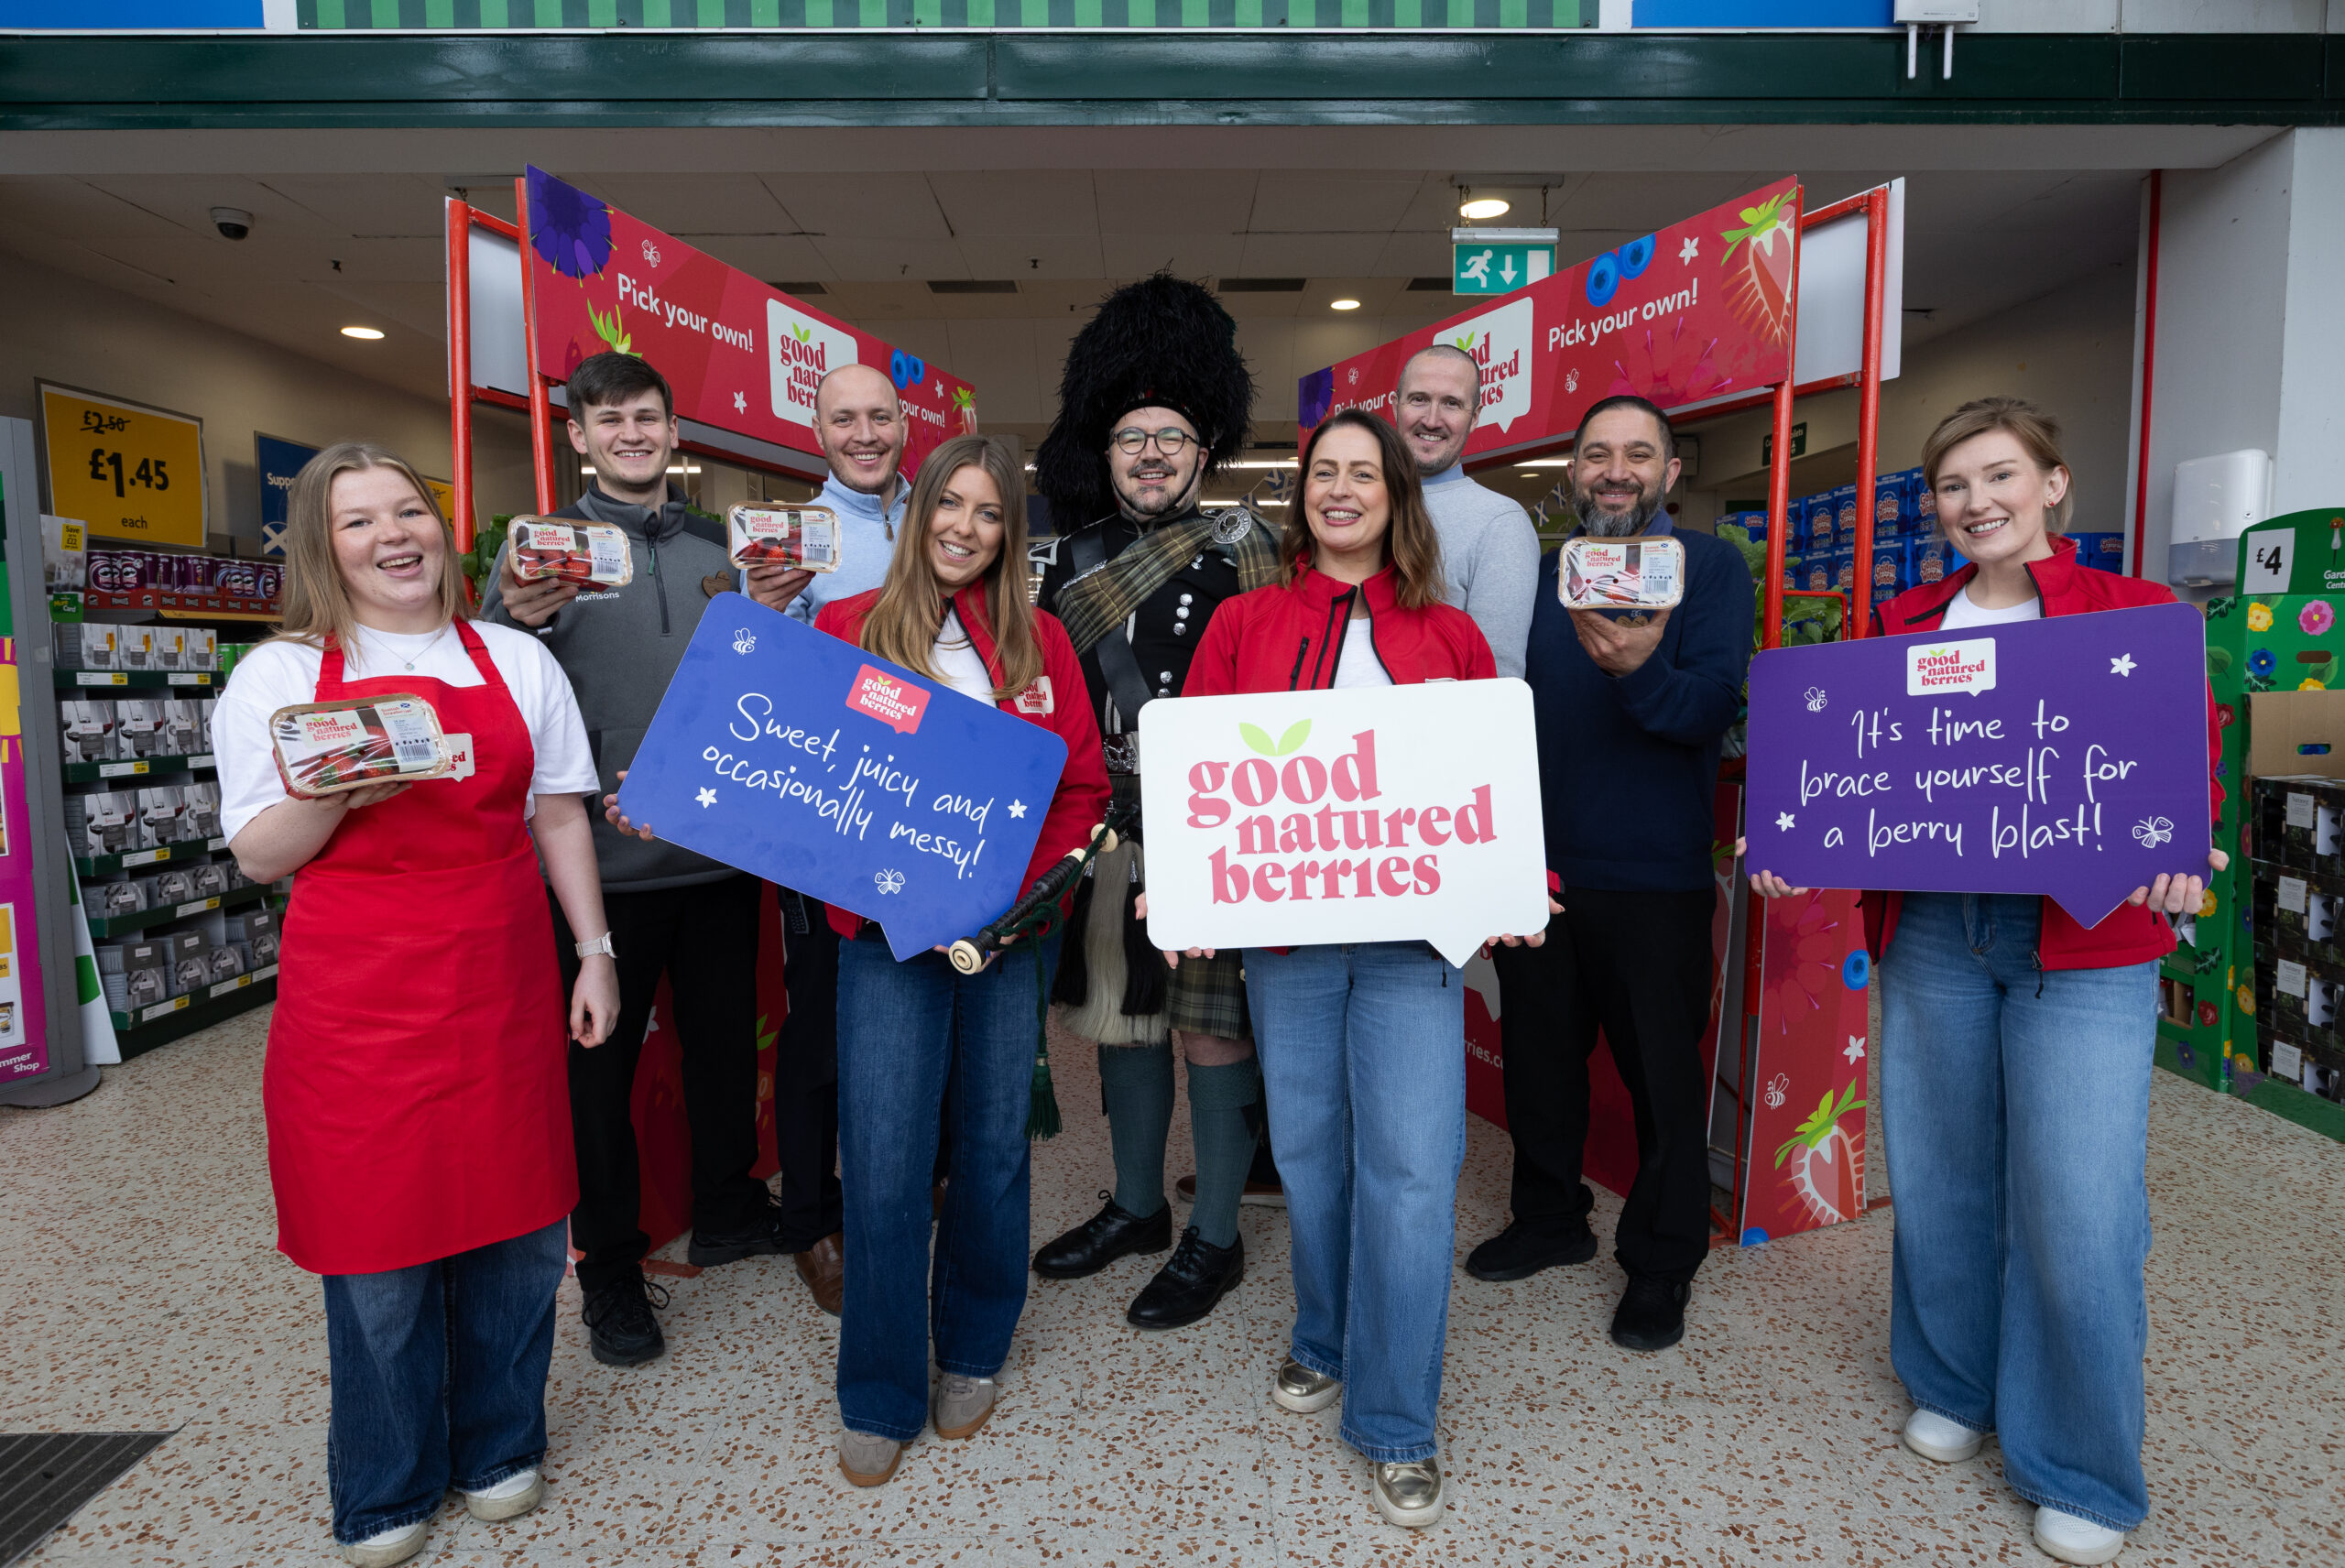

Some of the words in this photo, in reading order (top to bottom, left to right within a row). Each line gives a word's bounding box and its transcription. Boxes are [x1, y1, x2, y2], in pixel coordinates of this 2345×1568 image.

[618, 272, 661, 317] Pick
[664, 300, 708, 336] your
[712, 322, 754, 354] own!
[1548, 323, 1587, 354] Pick
[1589, 303, 1637, 347] your
[1642, 277, 1699, 320] own!
[780, 333, 827, 372] good
[82, 410, 126, 435] £2.50
[921, 408, 945, 429] own!
[88, 448, 170, 499] £1.45
[1877, 496, 1899, 513] Golden
[749, 514, 772, 525] good
[1838, 506, 1856, 521] Golde
[1877, 510, 1899, 524] Wonder
[65, 525, 81, 535] Save
[121, 515, 148, 530] each
[752, 526, 779, 534] berries
[534, 528, 558, 539] good
[1585, 549, 1609, 560] good
[2256, 545, 2283, 576] £4
[1875, 561, 1896, 576] Golden
[1921, 556, 1944, 572] Golden
[1874, 573, 1896, 587] Wonder
[1920, 569, 1944, 583] Wonder
[575, 591, 620, 603] Morrisons
[62, 604, 76, 613] Card
[1916, 648, 1961, 672] good
[1927, 659, 1986, 677] natured
[1920, 671, 1973, 687] berries
[861, 676, 902, 702] good
[859, 693, 904, 721] berries
[868, 689, 918, 719] natured
[306, 717, 338, 732] good
[316, 722, 358, 735] natured
[1851, 706, 1903, 758] It's
[1926, 707, 2005, 746] time
[2032, 699, 2069, 740] to
[312, 731, 352, 742] berries
[729, 691, 840, 773] Sweet,
[839, 744, 920, 807] juicy
[933, 797, 996, 834] and
[1187, 728, 1382, 829] good
[1800, 759, 1892, 806] brace
[1915, 746, 2060, 805] yourself
[2083, 744, 2138, 804] for
[702, 745, 873, 841] occasionally
[889, 821, 986, 880] messy!
[1235, 783, 1498, 855] natured
[1824, 825, 1844, 850] a
[1869, 807, 1963, 858] berry
[1991, 802, 2103, 859] blast!
[1207, 844, 1441, 905] berries
[13, 1061, 40, 1073] Shop
